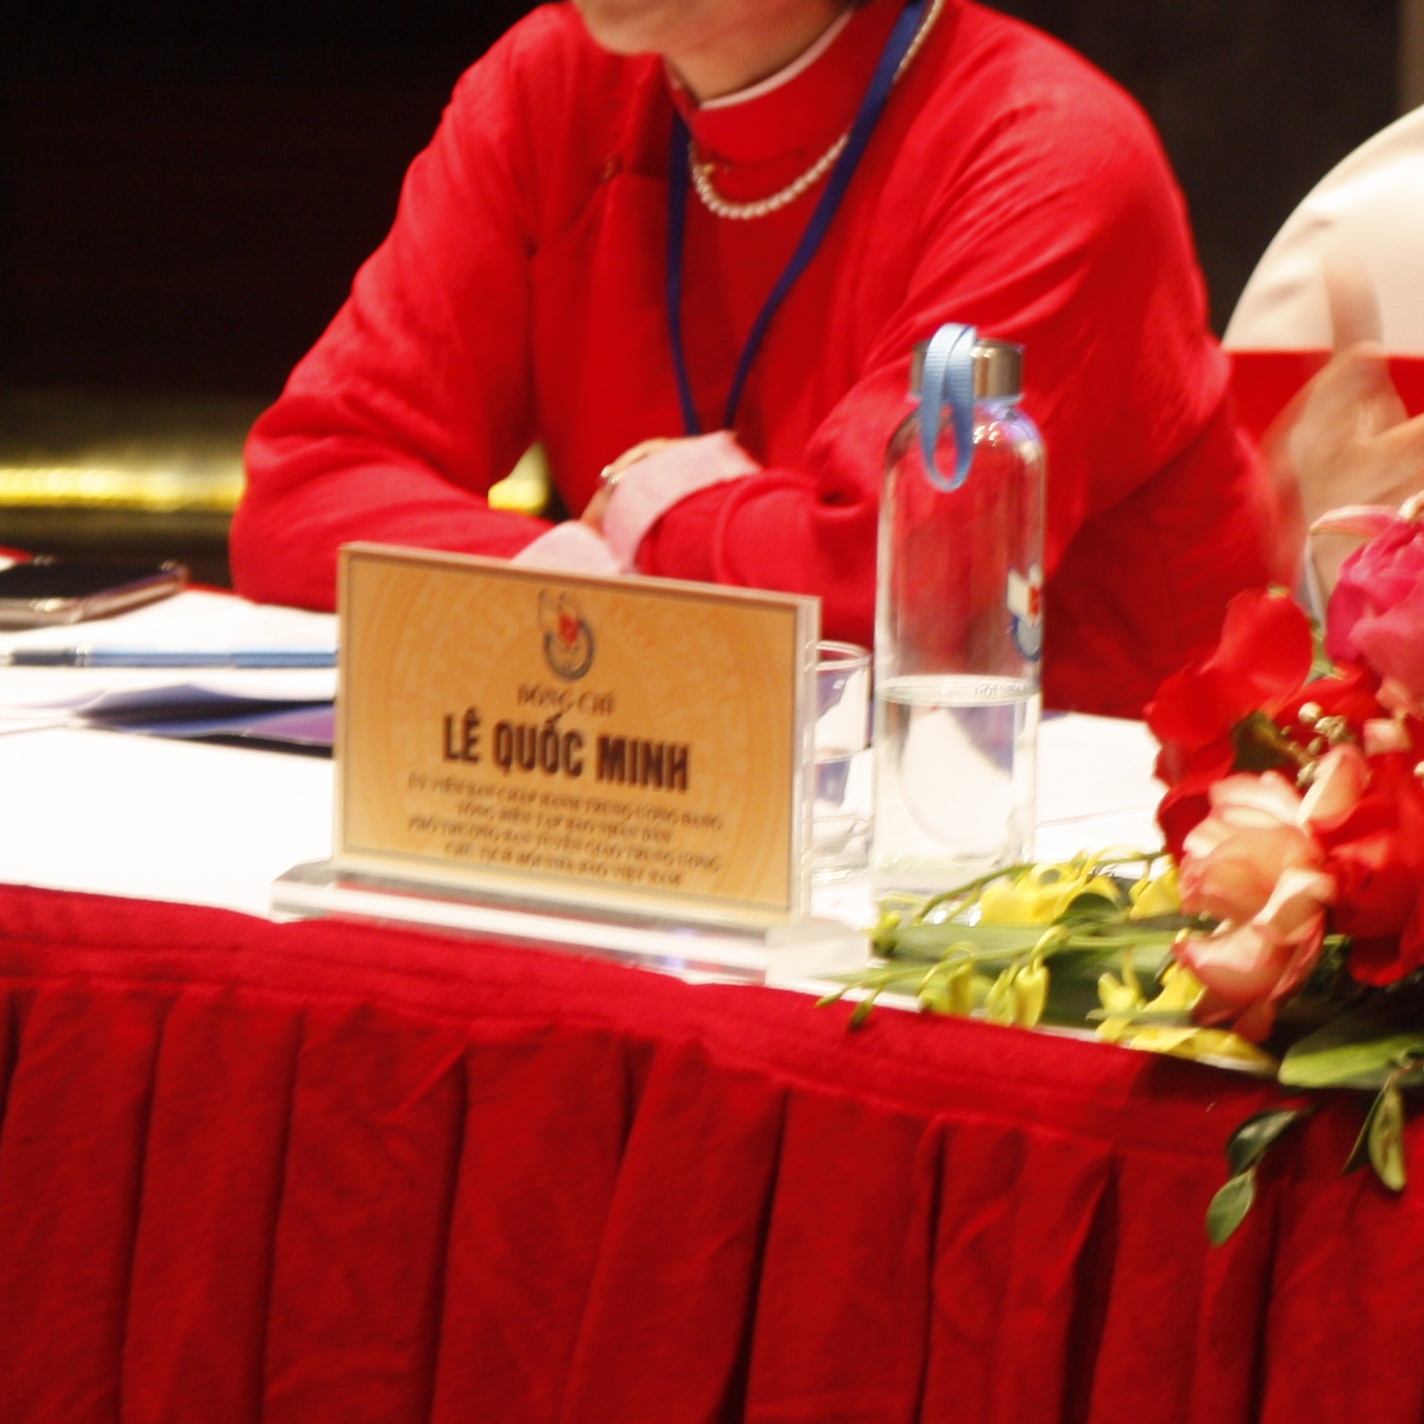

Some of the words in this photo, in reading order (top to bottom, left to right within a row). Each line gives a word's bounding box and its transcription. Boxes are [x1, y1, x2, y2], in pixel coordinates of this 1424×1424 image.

[442, 704, 481, 764] LÊ
[492, 711, 584, 778] QUỐC
[596, 730, 690, 794] MINH
